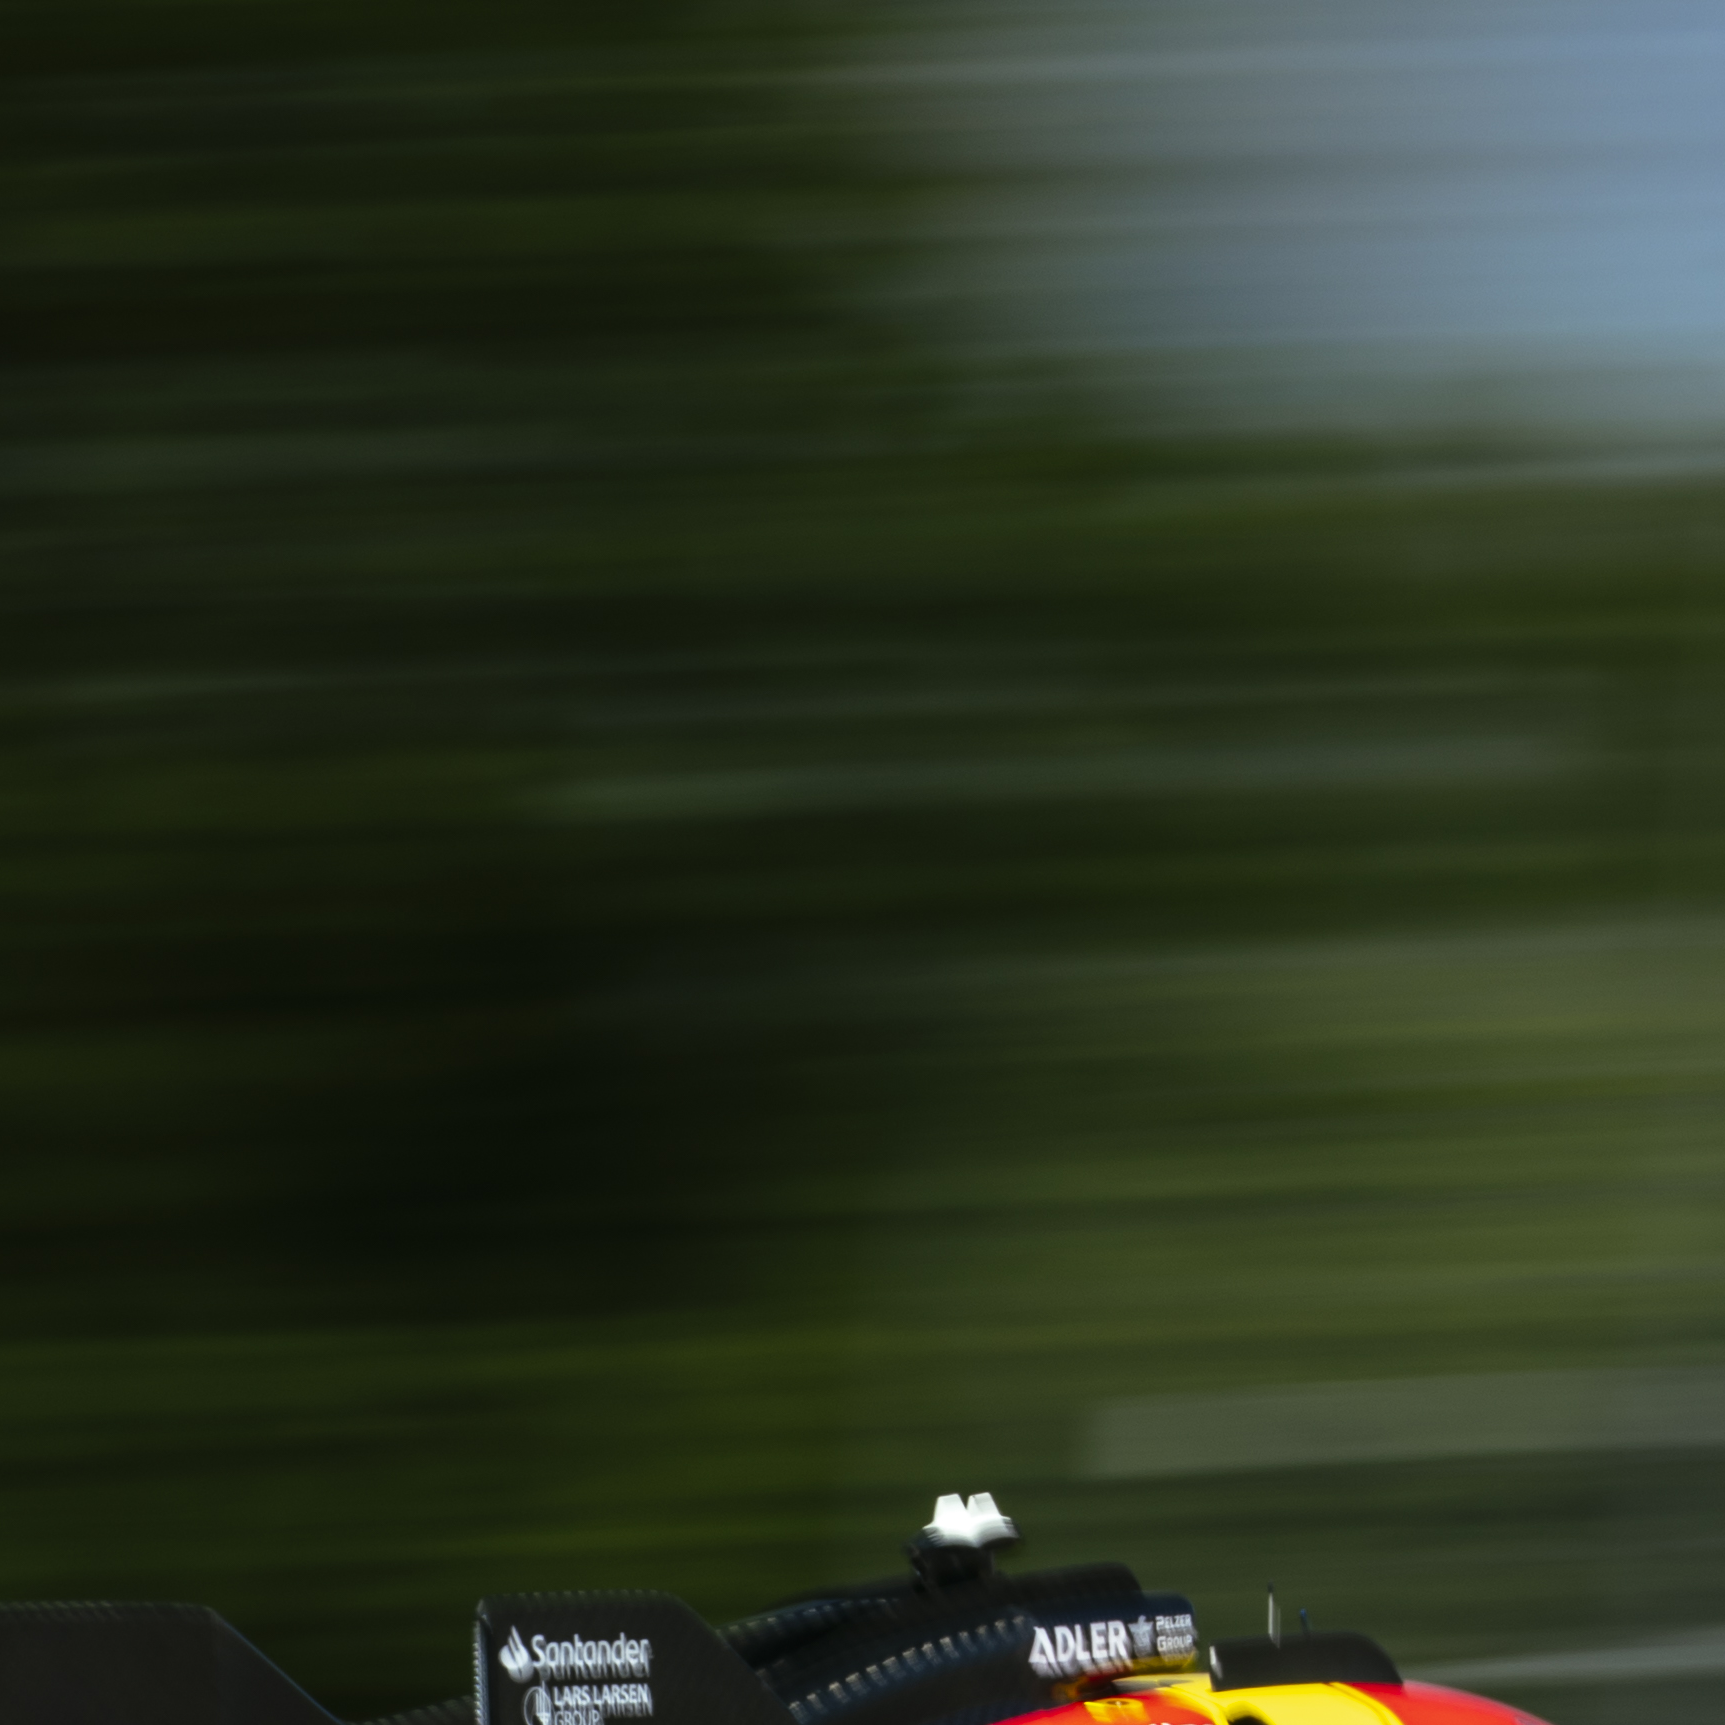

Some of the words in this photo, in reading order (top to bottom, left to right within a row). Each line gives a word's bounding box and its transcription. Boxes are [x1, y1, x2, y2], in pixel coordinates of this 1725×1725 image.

[1156, 1613, 1193, 1635] PELZER
[531, 1632, 652, 1677] Santander
[1028, 1619, 1132, 1674] ADLER
[1156, 1634, 1196, 1656] GROUP
[553, 1685, 591, 1708] LARS
[592, 1683, 653, 1713] LARSEN
